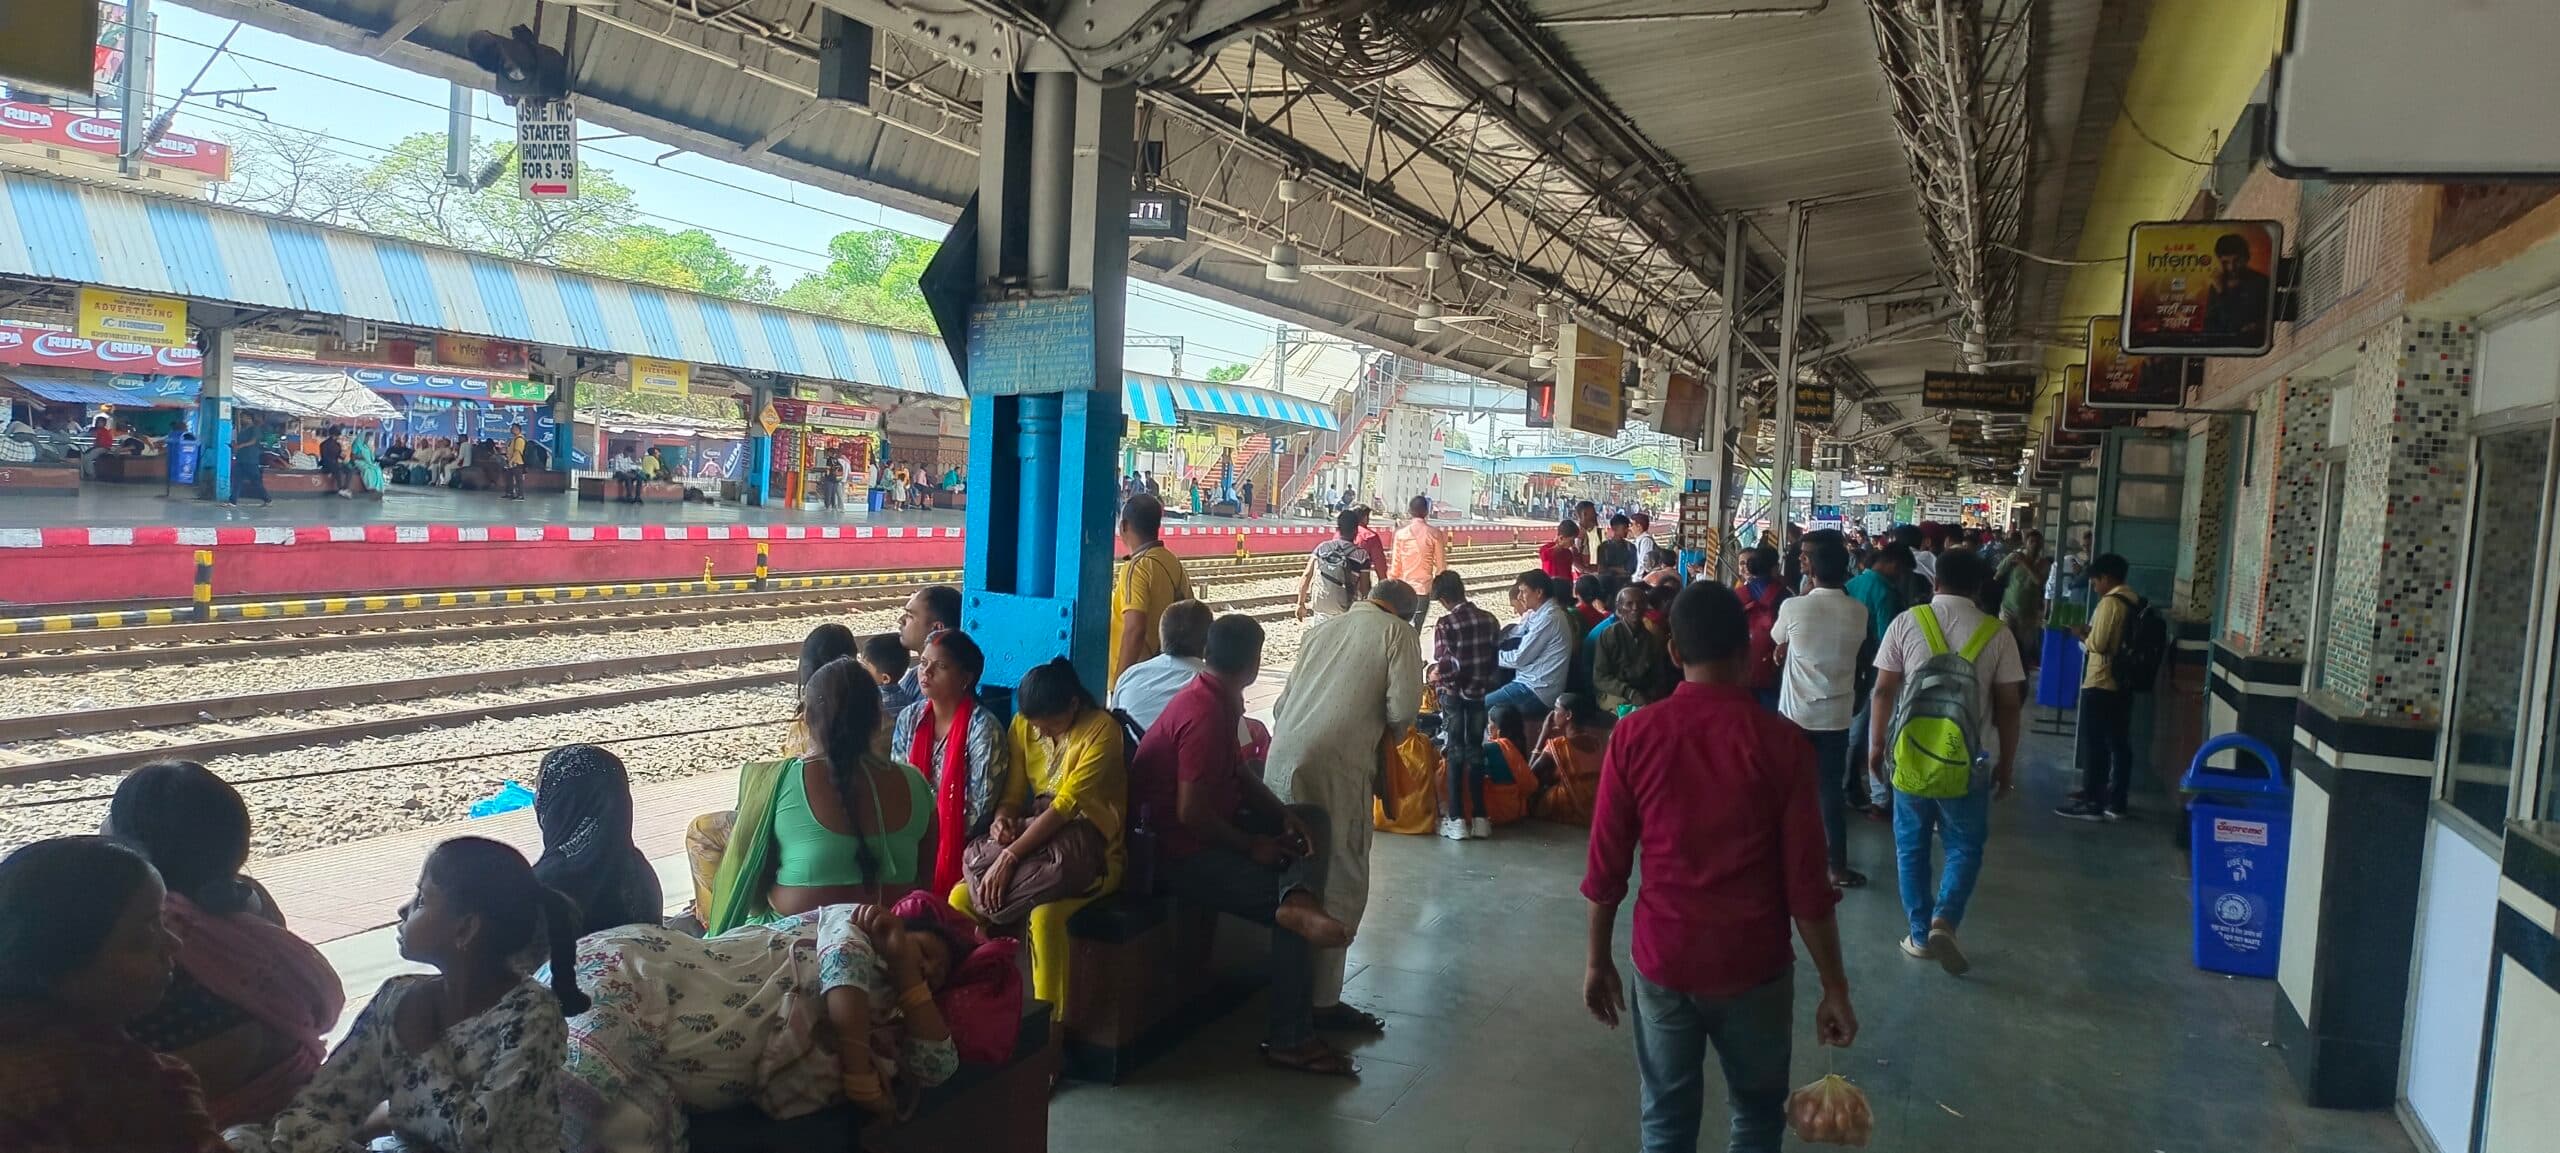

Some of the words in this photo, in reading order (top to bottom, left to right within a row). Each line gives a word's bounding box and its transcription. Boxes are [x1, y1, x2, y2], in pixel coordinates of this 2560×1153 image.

[4, 106, 52, 126] RUPA
[556, 103, 573, 121] WC
[522, 125, 570, 141] STARTER
[522, 143, 571, 160] INDICATOR
[522, 163, 542, 179] FOR
[545, 163, 552, 179] S
[561, 163, 573, 179] 59
[2147, 252, 2212, 268] Inferno
[94, 302, 173, 318] ADVERTISING
[48, 336, 93, 350] RUPA
[111, 341, 153, 355] RUPA
[117, 379, 144, 387] RUPA
[1274, 439, 1284, 453] 2
[2217, 821, 2264, 835] Supreme
